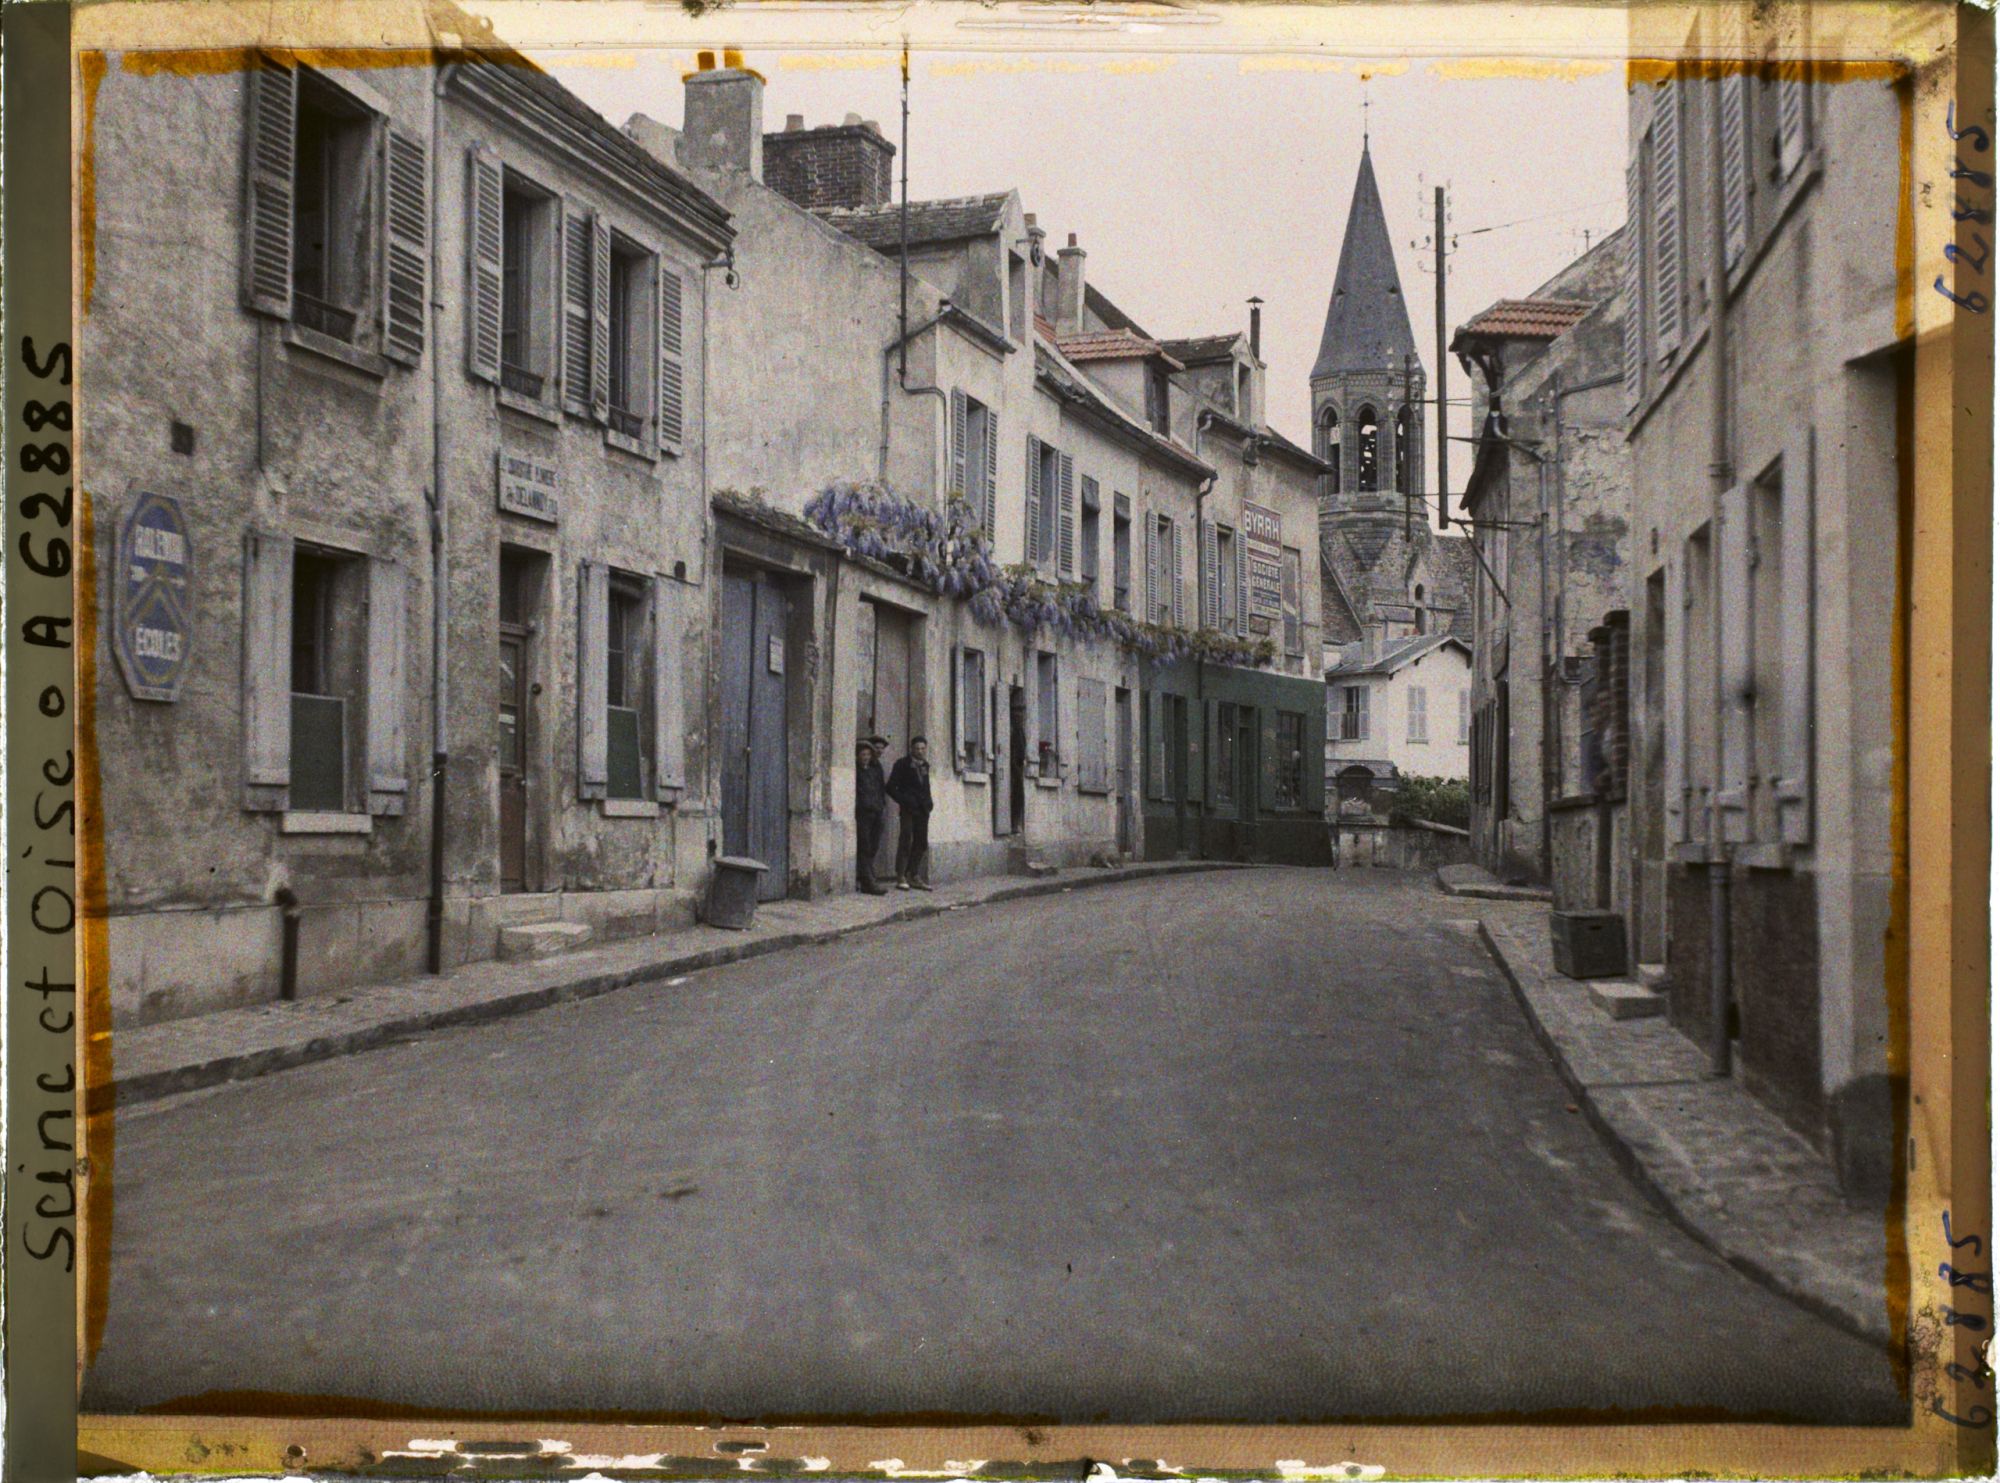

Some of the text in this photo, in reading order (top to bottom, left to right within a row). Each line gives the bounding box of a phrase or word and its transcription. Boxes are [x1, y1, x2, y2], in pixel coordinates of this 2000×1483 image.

[1933, 98, 1993, 314] 62885
[18, 335, 73, 578] 62885
[1244, 510, 1280, 541] BYRRH
[21, 615, 73, 649] A
[22, 749, 76, 935] Oise
[24, 965, 76, 1034] et
[18, 1063, 76, 1273] Seine
[1932, 1209, 1993, 1430] 62885
